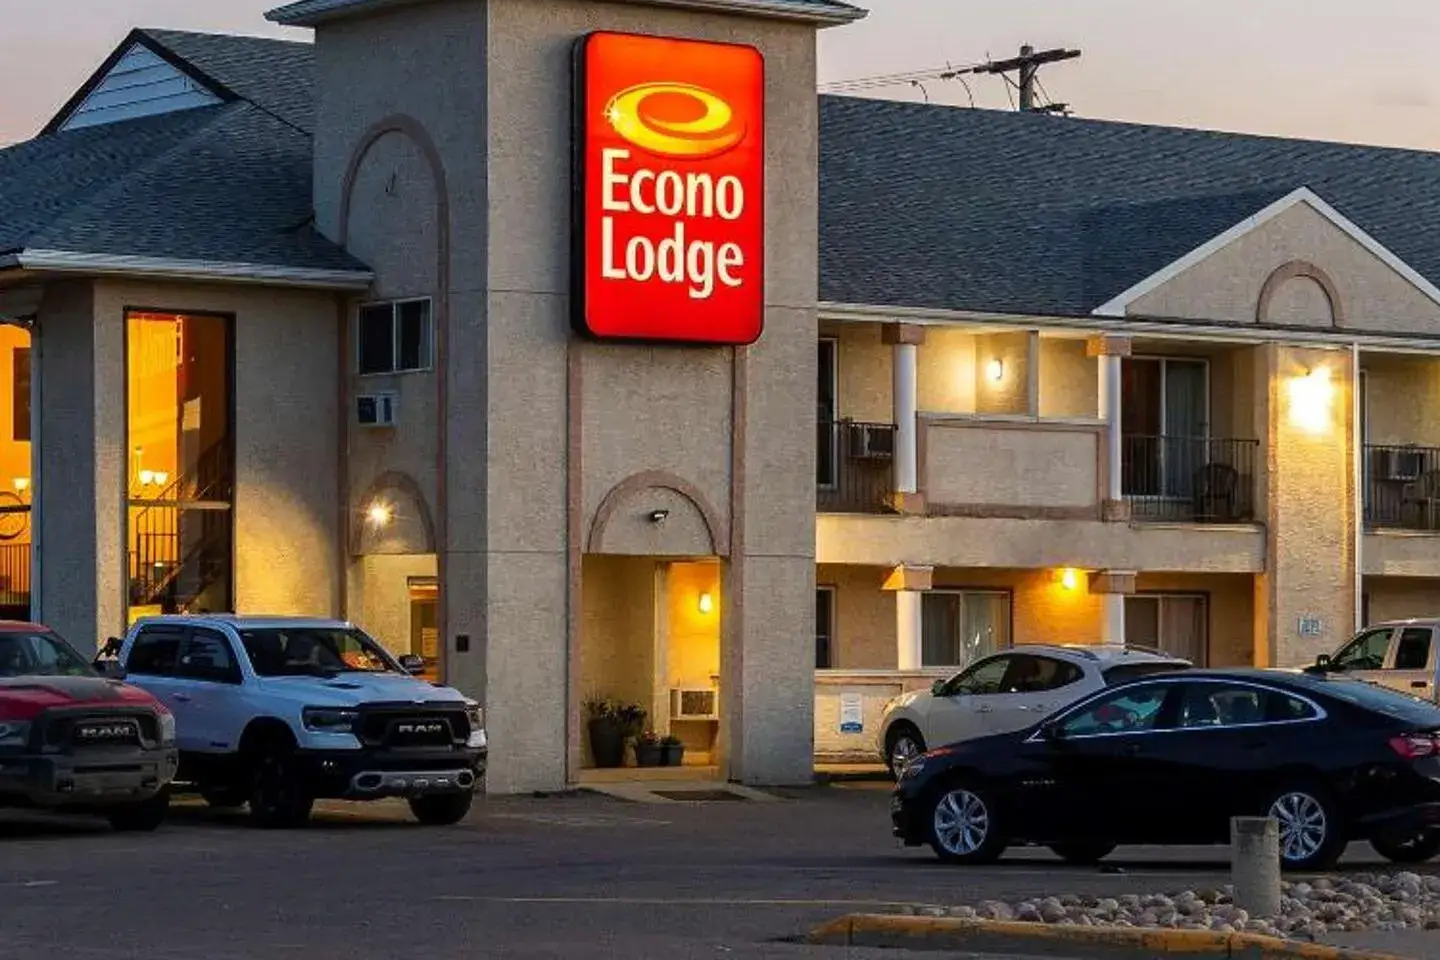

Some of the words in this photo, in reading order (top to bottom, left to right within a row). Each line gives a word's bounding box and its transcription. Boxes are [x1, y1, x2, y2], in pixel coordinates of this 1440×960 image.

[601, 148, 744, 220] Econo
[601, 216, 744, 299] Lodge
[399, 724, 442, 733] RAM
